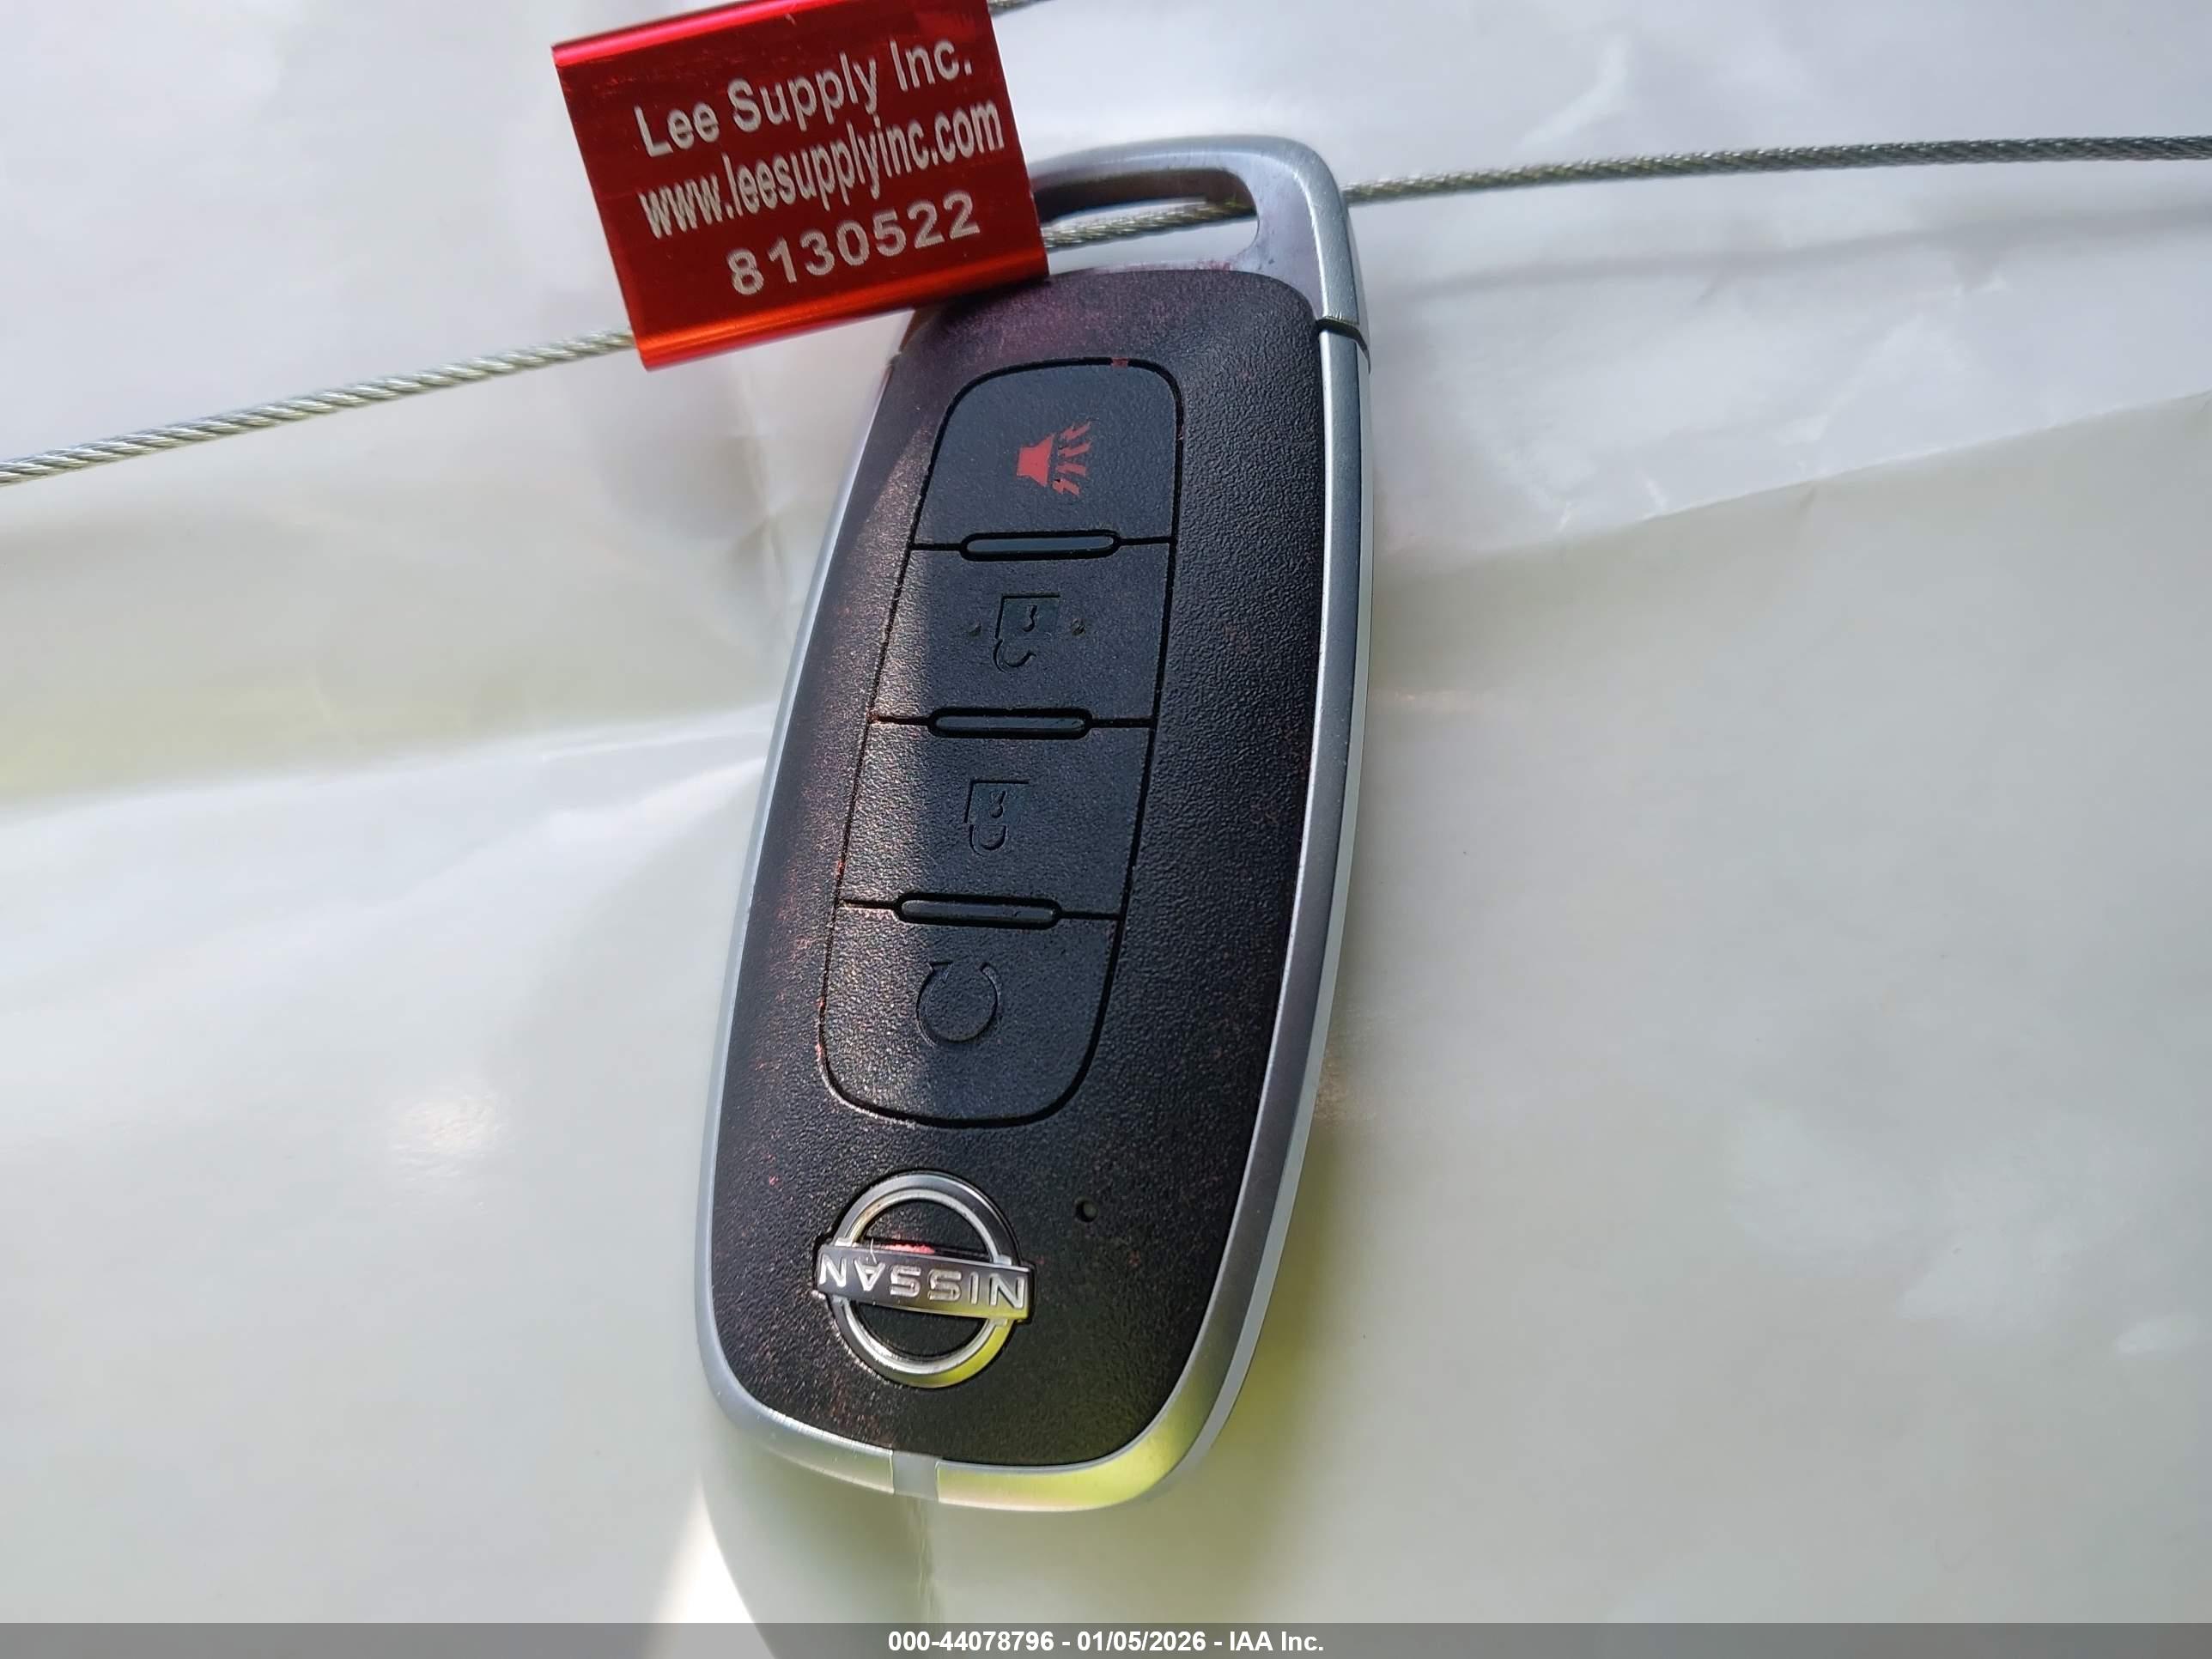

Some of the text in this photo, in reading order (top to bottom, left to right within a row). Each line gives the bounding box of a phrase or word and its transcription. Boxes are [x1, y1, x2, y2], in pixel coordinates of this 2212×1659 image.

[634, 37, 973, 158] Lee Supply Inc.
[638, 99, 1005, 240] www.leesupplyinc.com
[726, 191, 981, 296] 8130522
[818, 1254, 1025, 1310] NISSAN
